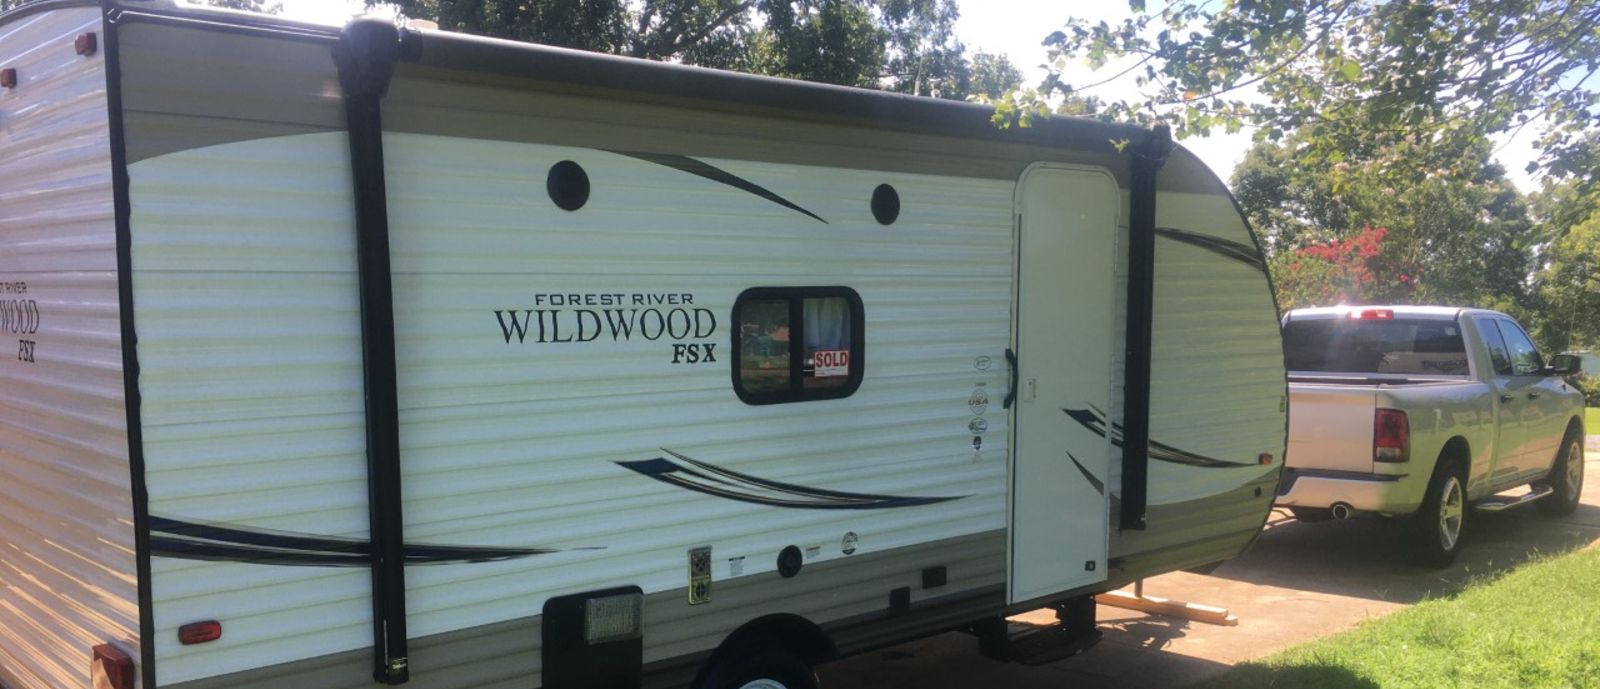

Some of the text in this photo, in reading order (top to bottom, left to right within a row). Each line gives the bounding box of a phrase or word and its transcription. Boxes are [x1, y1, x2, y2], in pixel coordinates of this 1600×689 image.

[535, 293, 694, 306] FOREST RIVER
[494, 308, 716, 344] WILDWOOD
[671, 343, 716, 364] FSX
[815, 351, 847, 368] SOLD
[968, 398, 989, 406] USA
